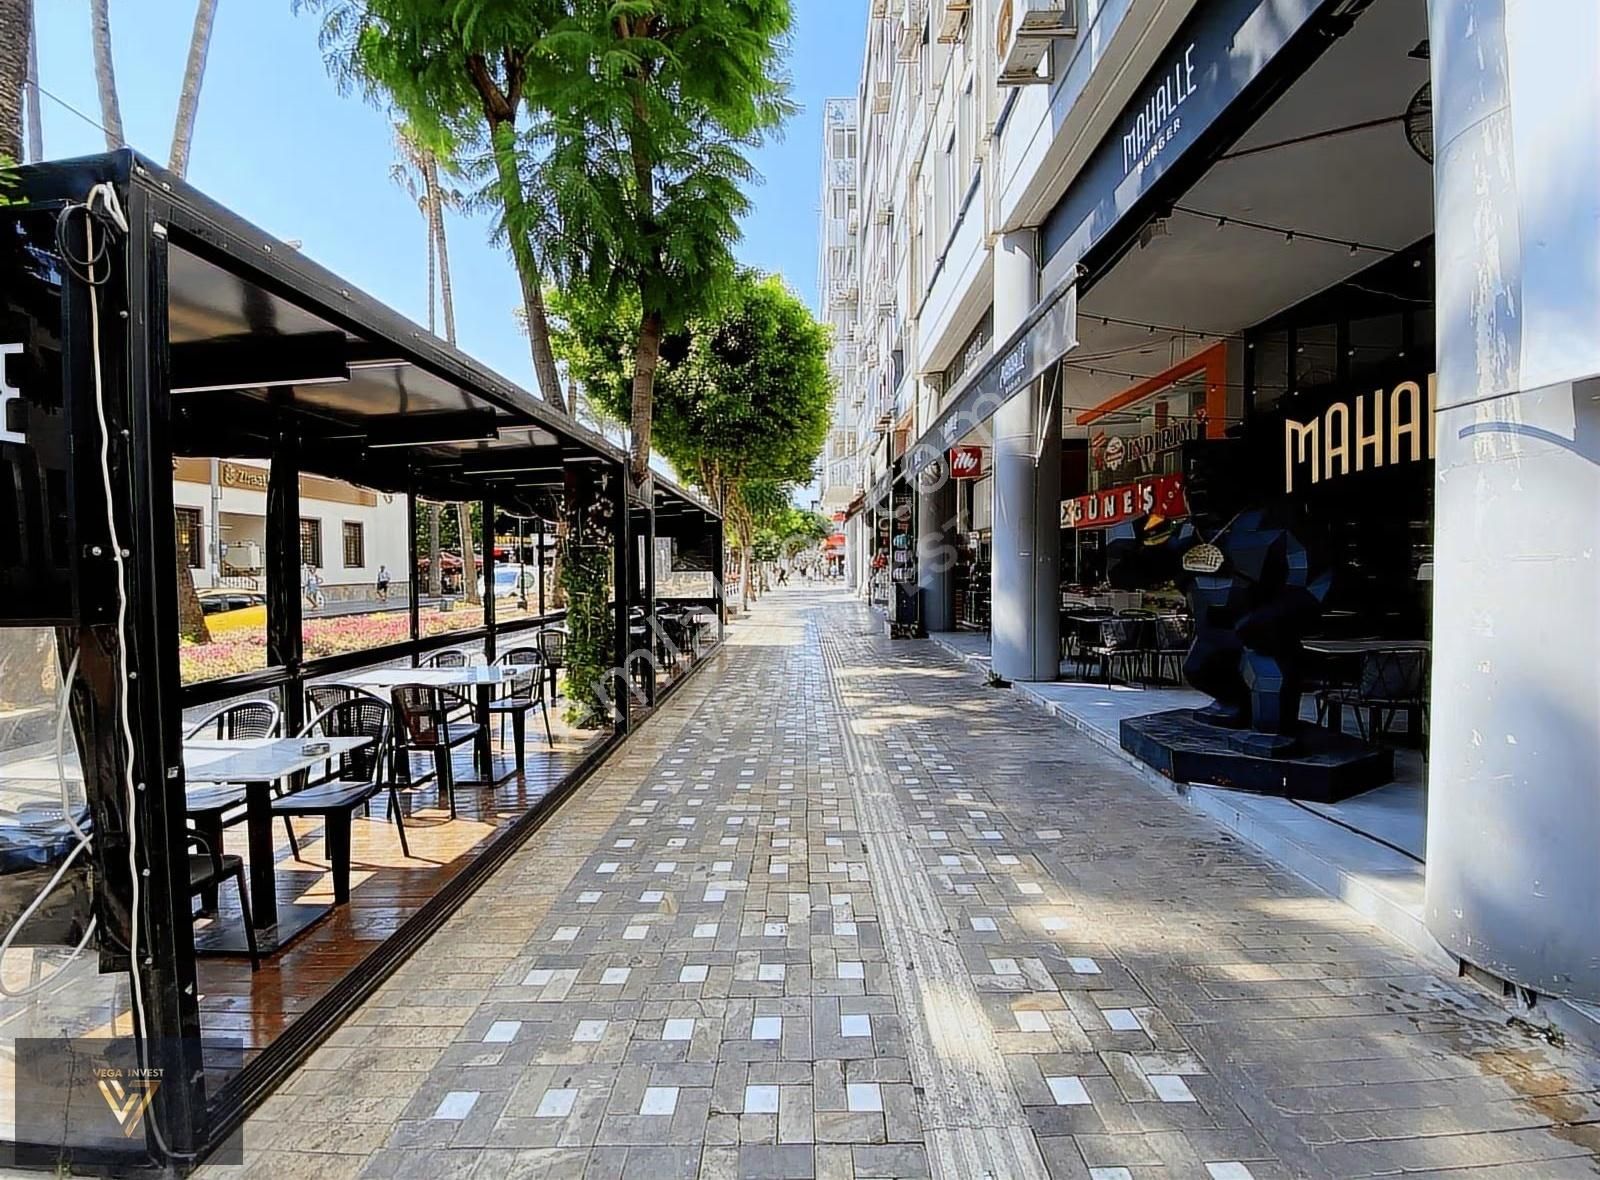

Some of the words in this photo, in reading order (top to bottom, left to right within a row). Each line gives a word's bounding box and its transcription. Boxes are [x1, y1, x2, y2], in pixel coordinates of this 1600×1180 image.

[1123, 42, 1197, 175] MAHALLE
[1136, 117, 1181, 175] BURGER
[953, 451, 979, 473] illy
